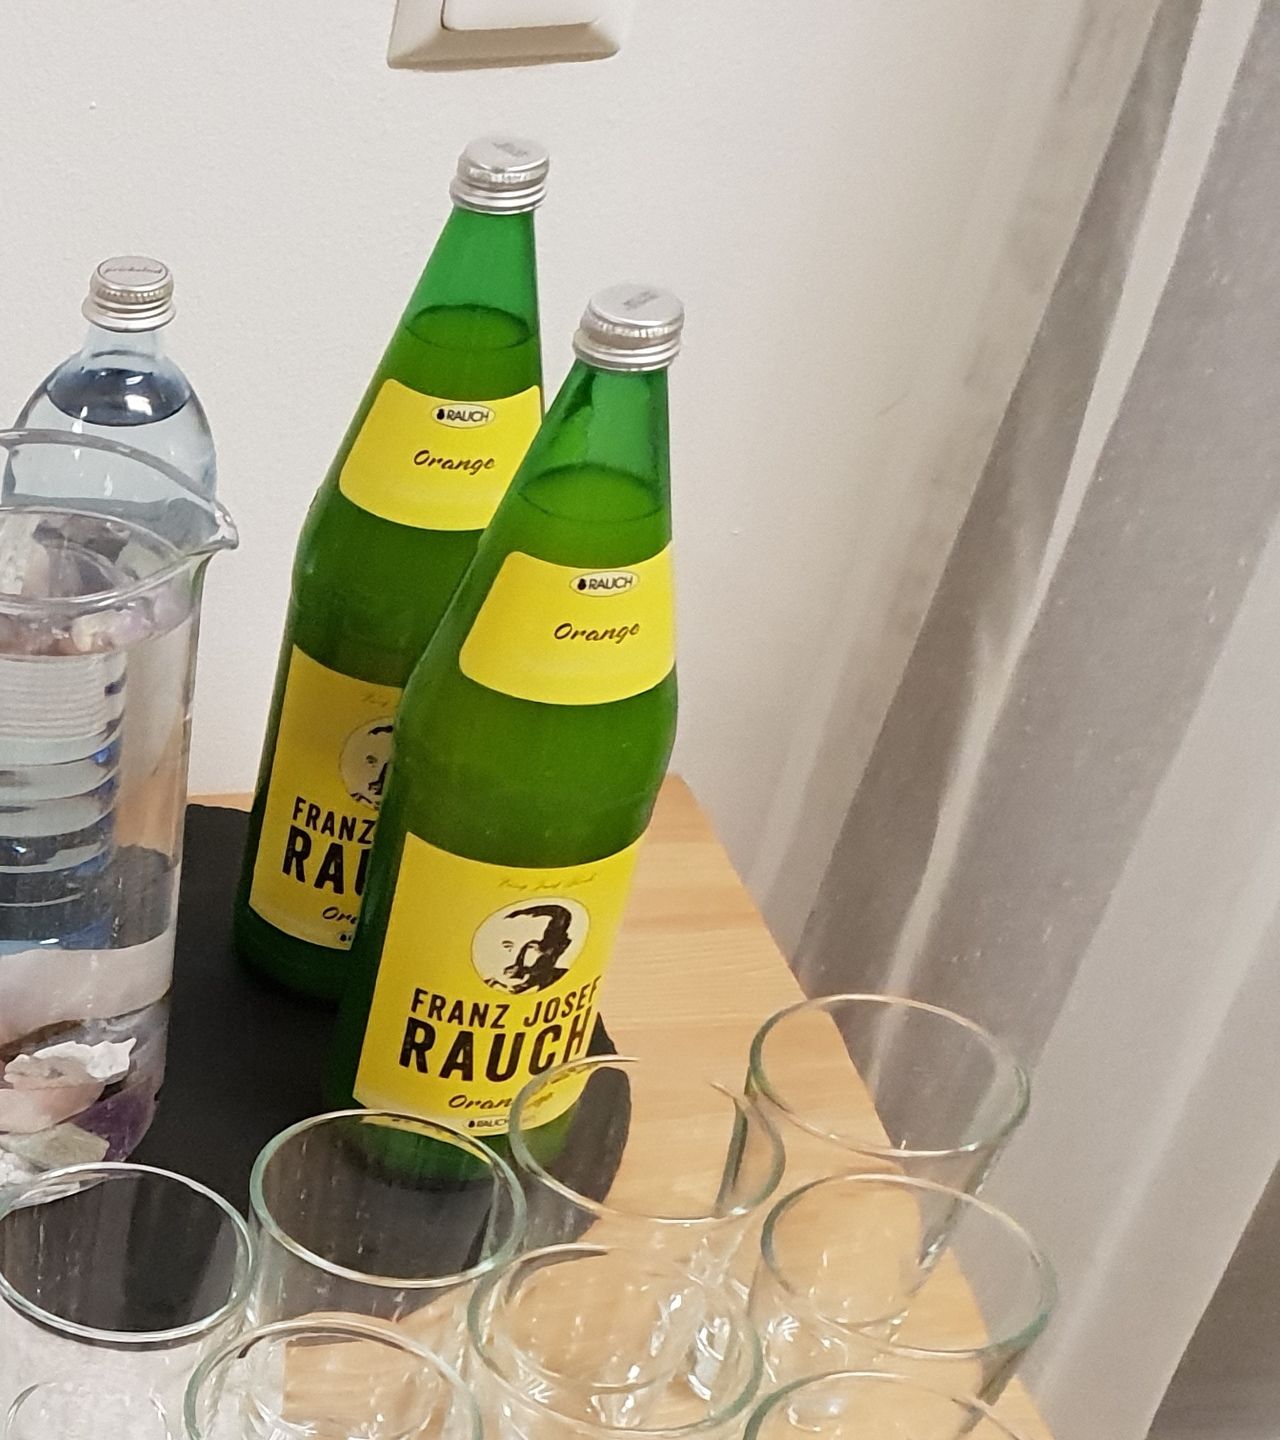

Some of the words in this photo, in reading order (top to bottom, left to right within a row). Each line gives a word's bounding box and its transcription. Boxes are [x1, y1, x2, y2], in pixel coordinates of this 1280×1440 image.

[447, 408, 489, 422] RAUCH
[413, 449, 496, 475] Orange
[588, 574, 634, 590] RAUCH
[553, 622, 641, 644] Orange
[292, 796, 377, 846] FRANZ
[411, 988, 510, 1029] FRANZ
[523, 975, 602, 1028] JOSEF
[399, 1006, 592, 1082] RAUCH
